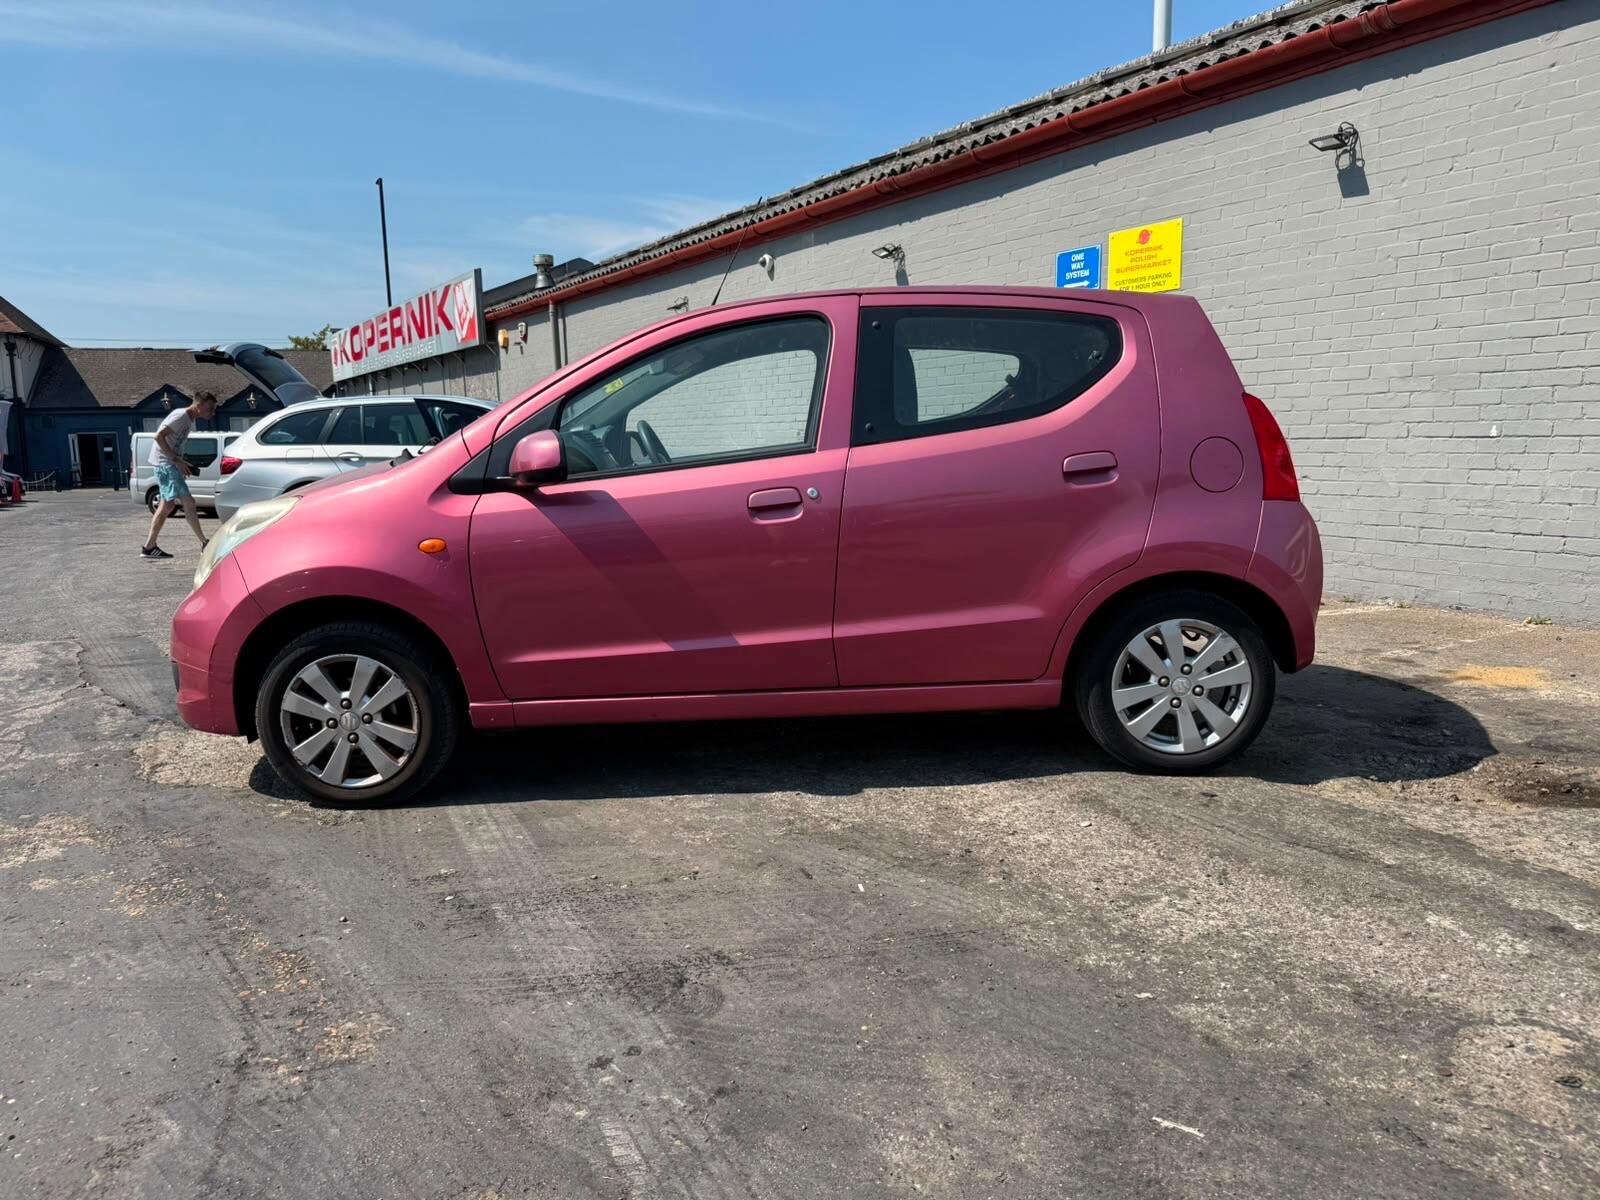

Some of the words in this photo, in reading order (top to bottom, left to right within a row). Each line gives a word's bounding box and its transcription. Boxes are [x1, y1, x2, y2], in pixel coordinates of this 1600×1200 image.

[1071, 252, 1085, 262] ONE
[1130, 253, 1157, 264] POLISH
[1071, 261, 1084, 271] WAY
[1116, 259, 1172, 274] SUPERMARKET
[1065, 269, 1090, 280] SYSTEM
[1115, 275, 1147, 287] CUSTOMERS
[1147, 272, 1173, 281] PARKING
[1135, 281, 1151, 290] HOUR
[1151, 280, 1167, 288] ONLY
[339, 284, 454, 365] KOPERNIK
